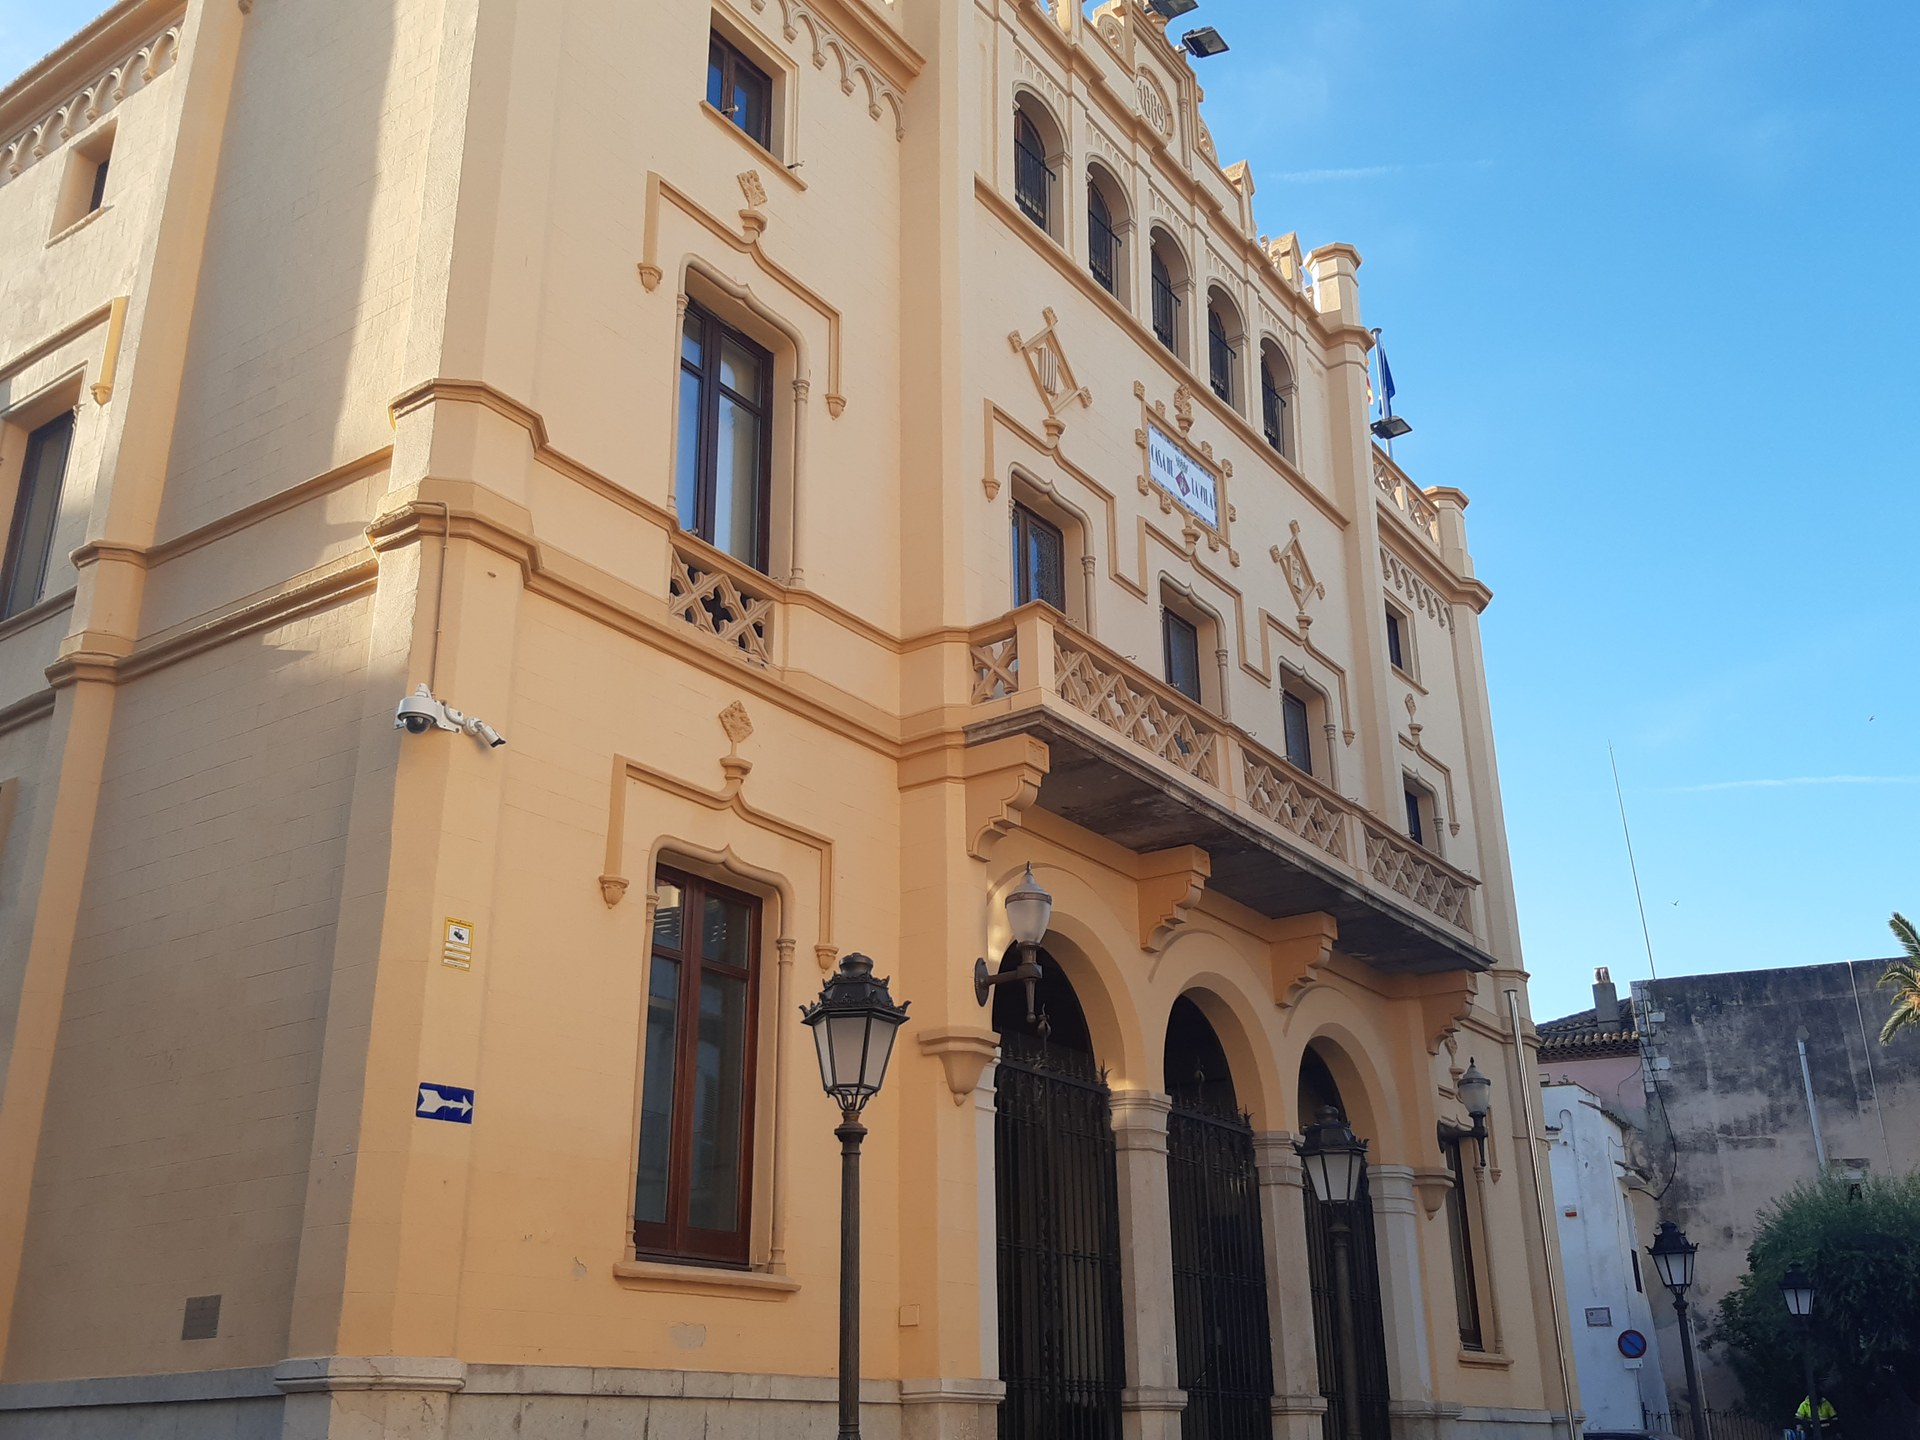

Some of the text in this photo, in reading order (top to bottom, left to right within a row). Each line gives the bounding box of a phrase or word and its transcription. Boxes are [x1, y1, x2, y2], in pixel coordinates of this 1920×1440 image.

[1137, 80, 1164, 133] 1889
[1151, 444, 1214, 511] CASA DE LA VILA
